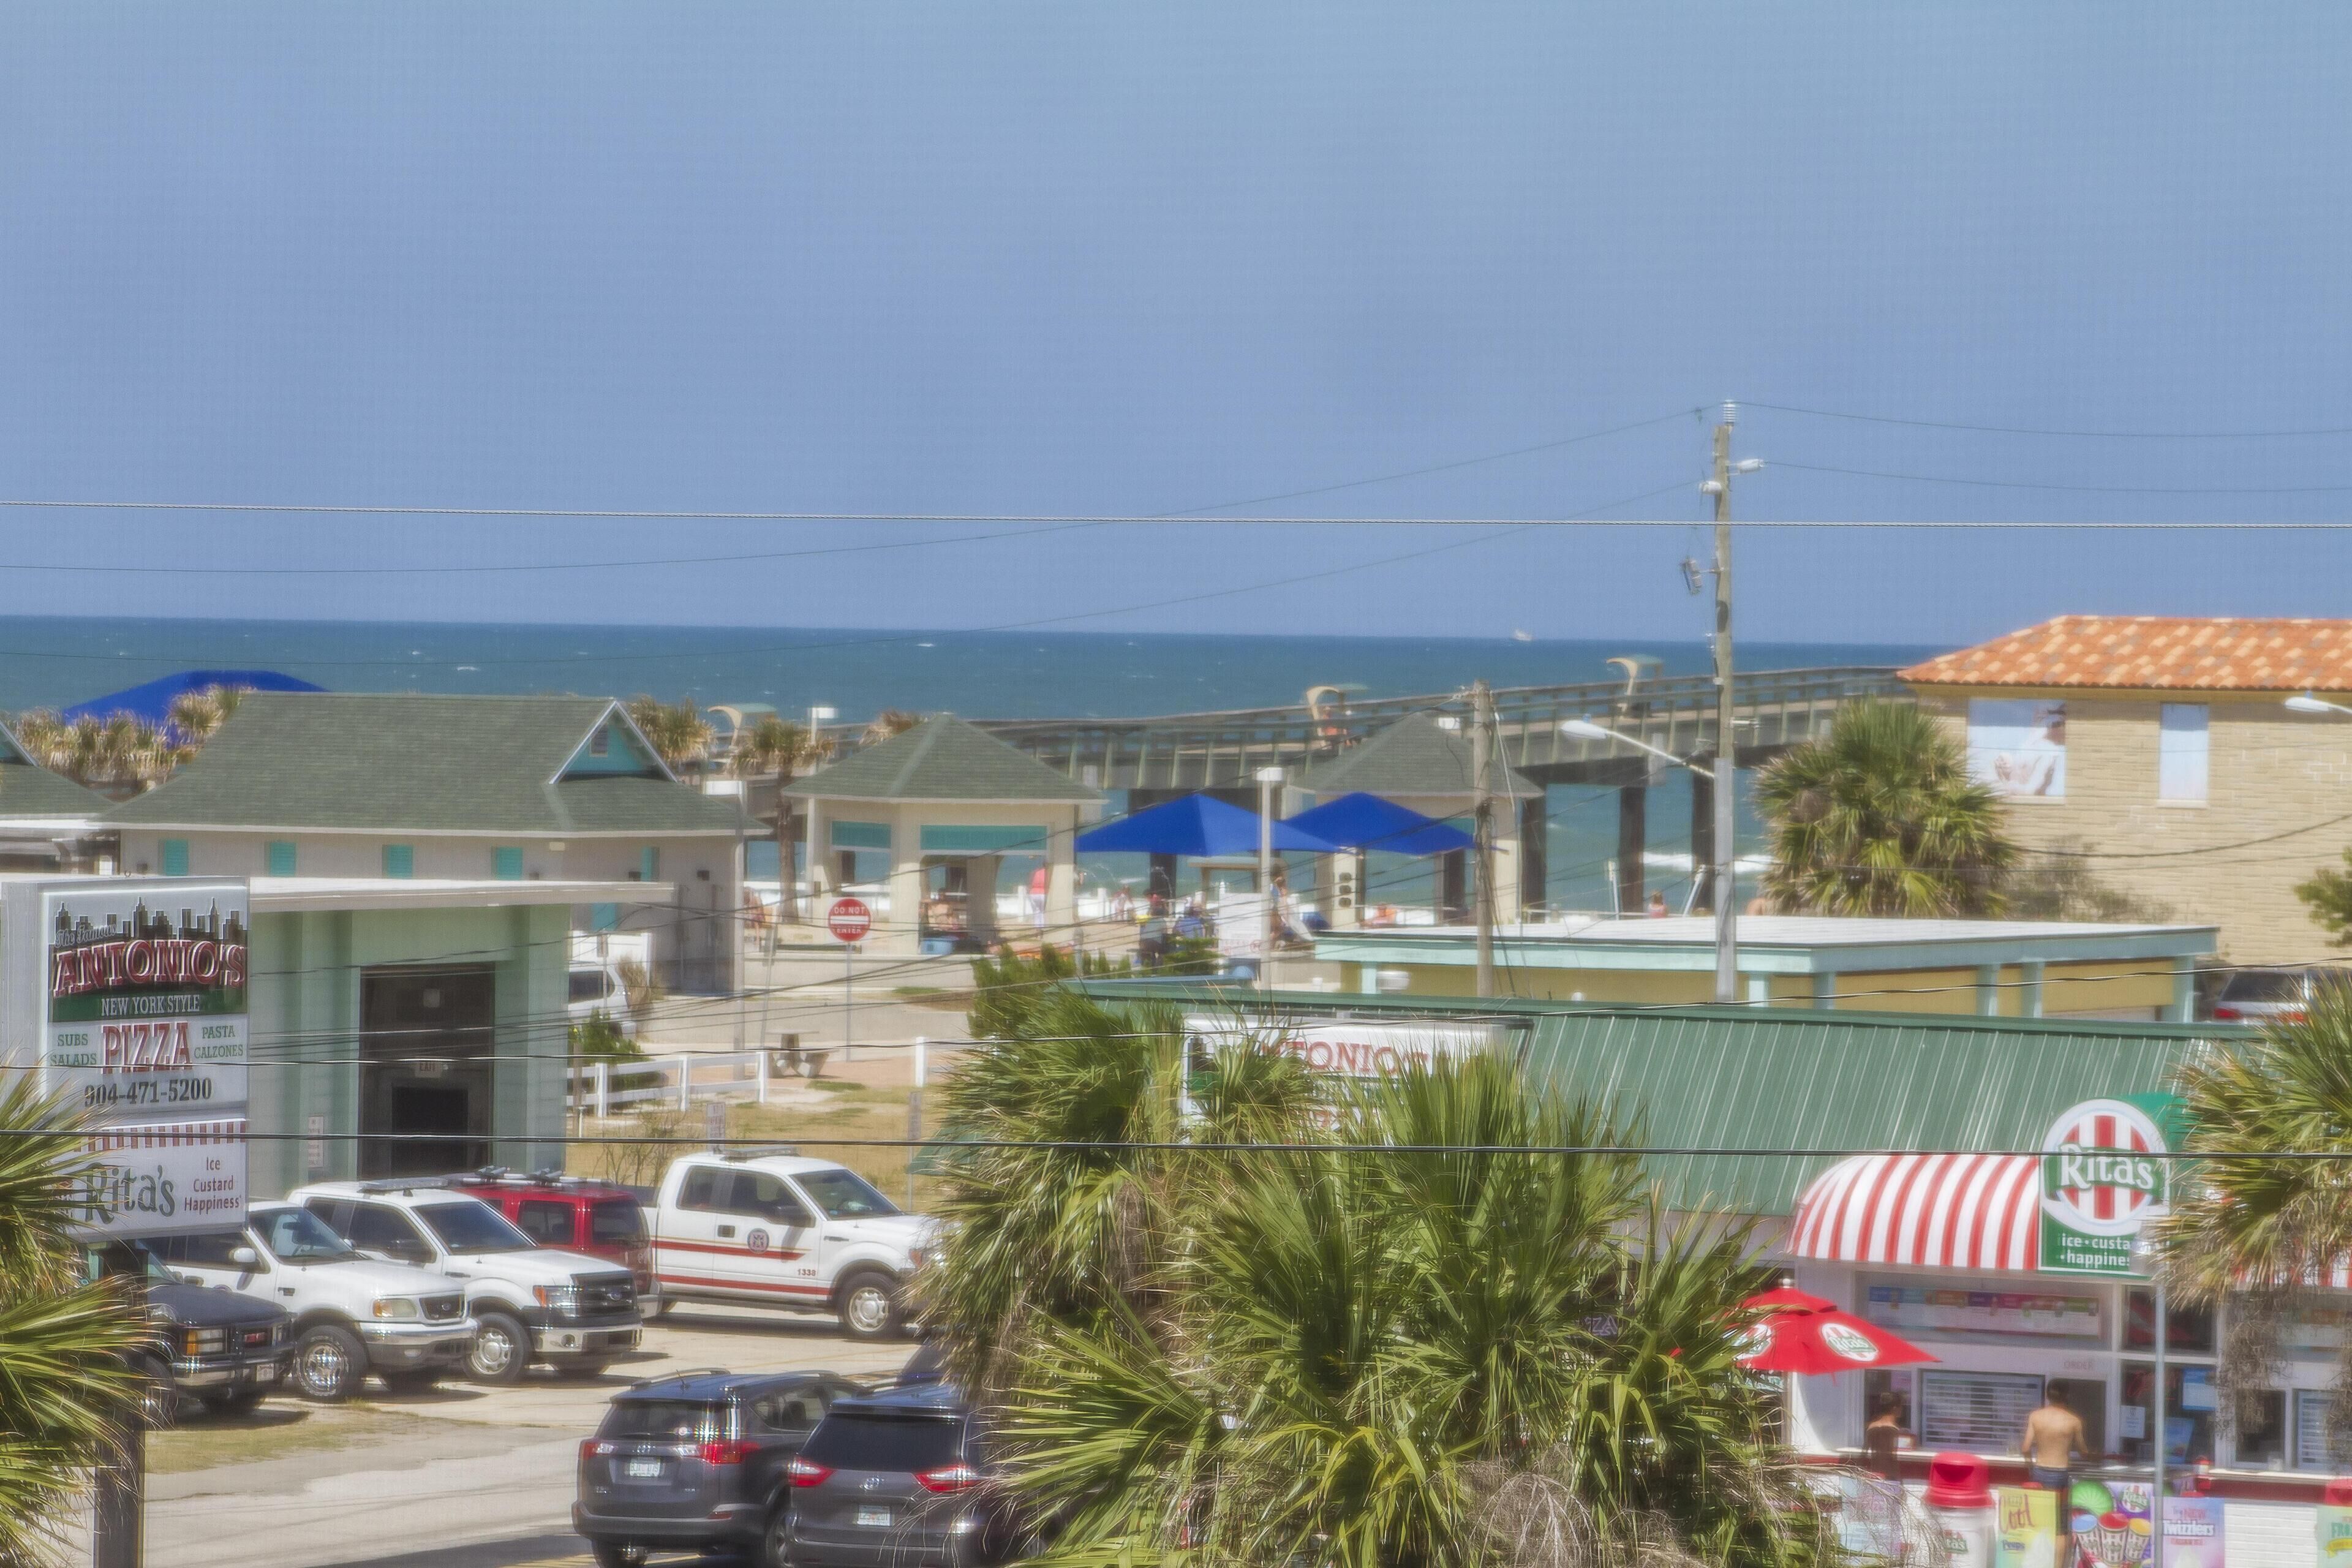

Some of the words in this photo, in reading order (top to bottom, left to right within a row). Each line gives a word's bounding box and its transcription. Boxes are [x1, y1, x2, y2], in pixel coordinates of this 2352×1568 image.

[55, 929, 75, 948] The
[76, 924, 117, 944] Famous
[837, 925, 861, 934] ENTER
[53, 940, 245, 997] ANTONIO'S
[102, 998, 130, 1016] NEW
[132, 996, 166, 1014] YORK
[168, 994, 200, 1012] STYLE
[58, 1033, 89, 1047] SUBS
[202, 1025, 235, 1039] PASTA
[101, 1021, 192, 1075] PIZZA
[194, 1044, 244, 1059] CALZONES
[50, 1053, 97, 1066] SALADS
[84, 1078, 212, 1107] 904-471-5200
[206, 1156, 221, 1171] Ice
[2061, 1144, 2154, 1189] Rita's
[193, 1175, 234, 1193] Custard
[85, 1162, 176, 1225] Rita's
[2062, 1233, 2082, 1247] ice
[2092, 1237, 2130, 1250] custa
[2067, 1250, 2130, 1267] happine
